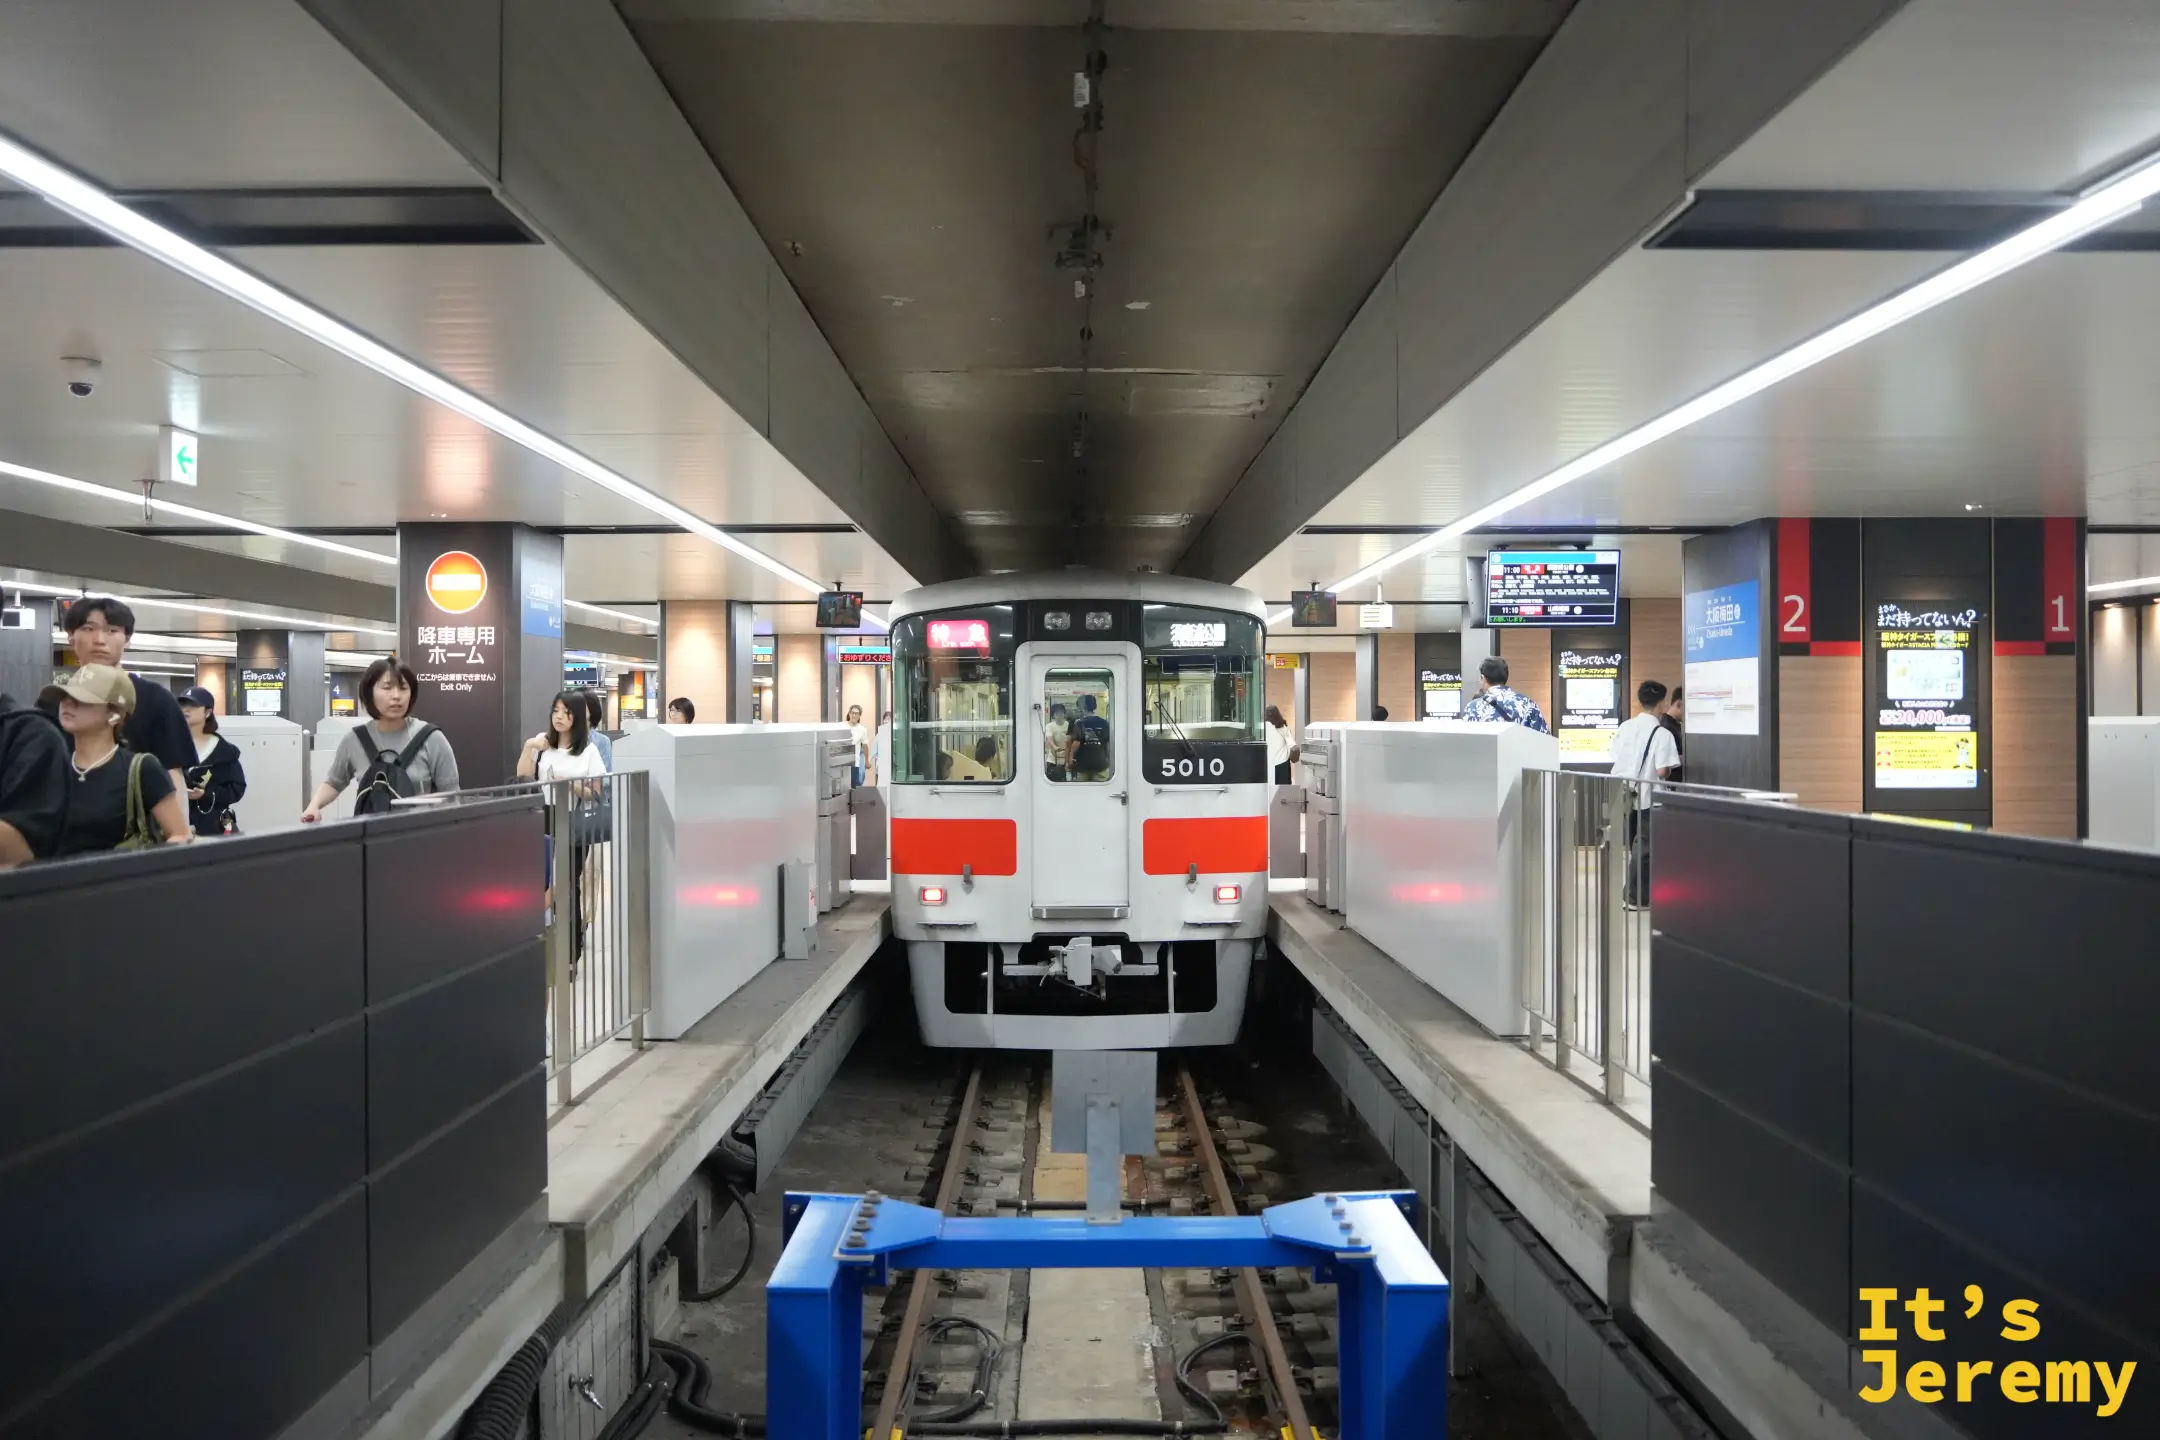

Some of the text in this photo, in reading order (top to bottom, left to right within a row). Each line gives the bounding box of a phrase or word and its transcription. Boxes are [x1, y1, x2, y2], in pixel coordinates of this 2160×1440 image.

[1502, 606, 1519, 614] 11:10
[1706, 604, 1734, 624] 大阪梅田
[1783, 594, 1806, 632] 2
[2051, 595, 2070, 632] 1
[417, 626, 495, 646] 降車専用
[428, 646, 485, 665] ホーム
[333, 685, 340, 694] 4
[440, 683, 473, 692] Exit Only
[1161, 758, 1225, 777] 5010
